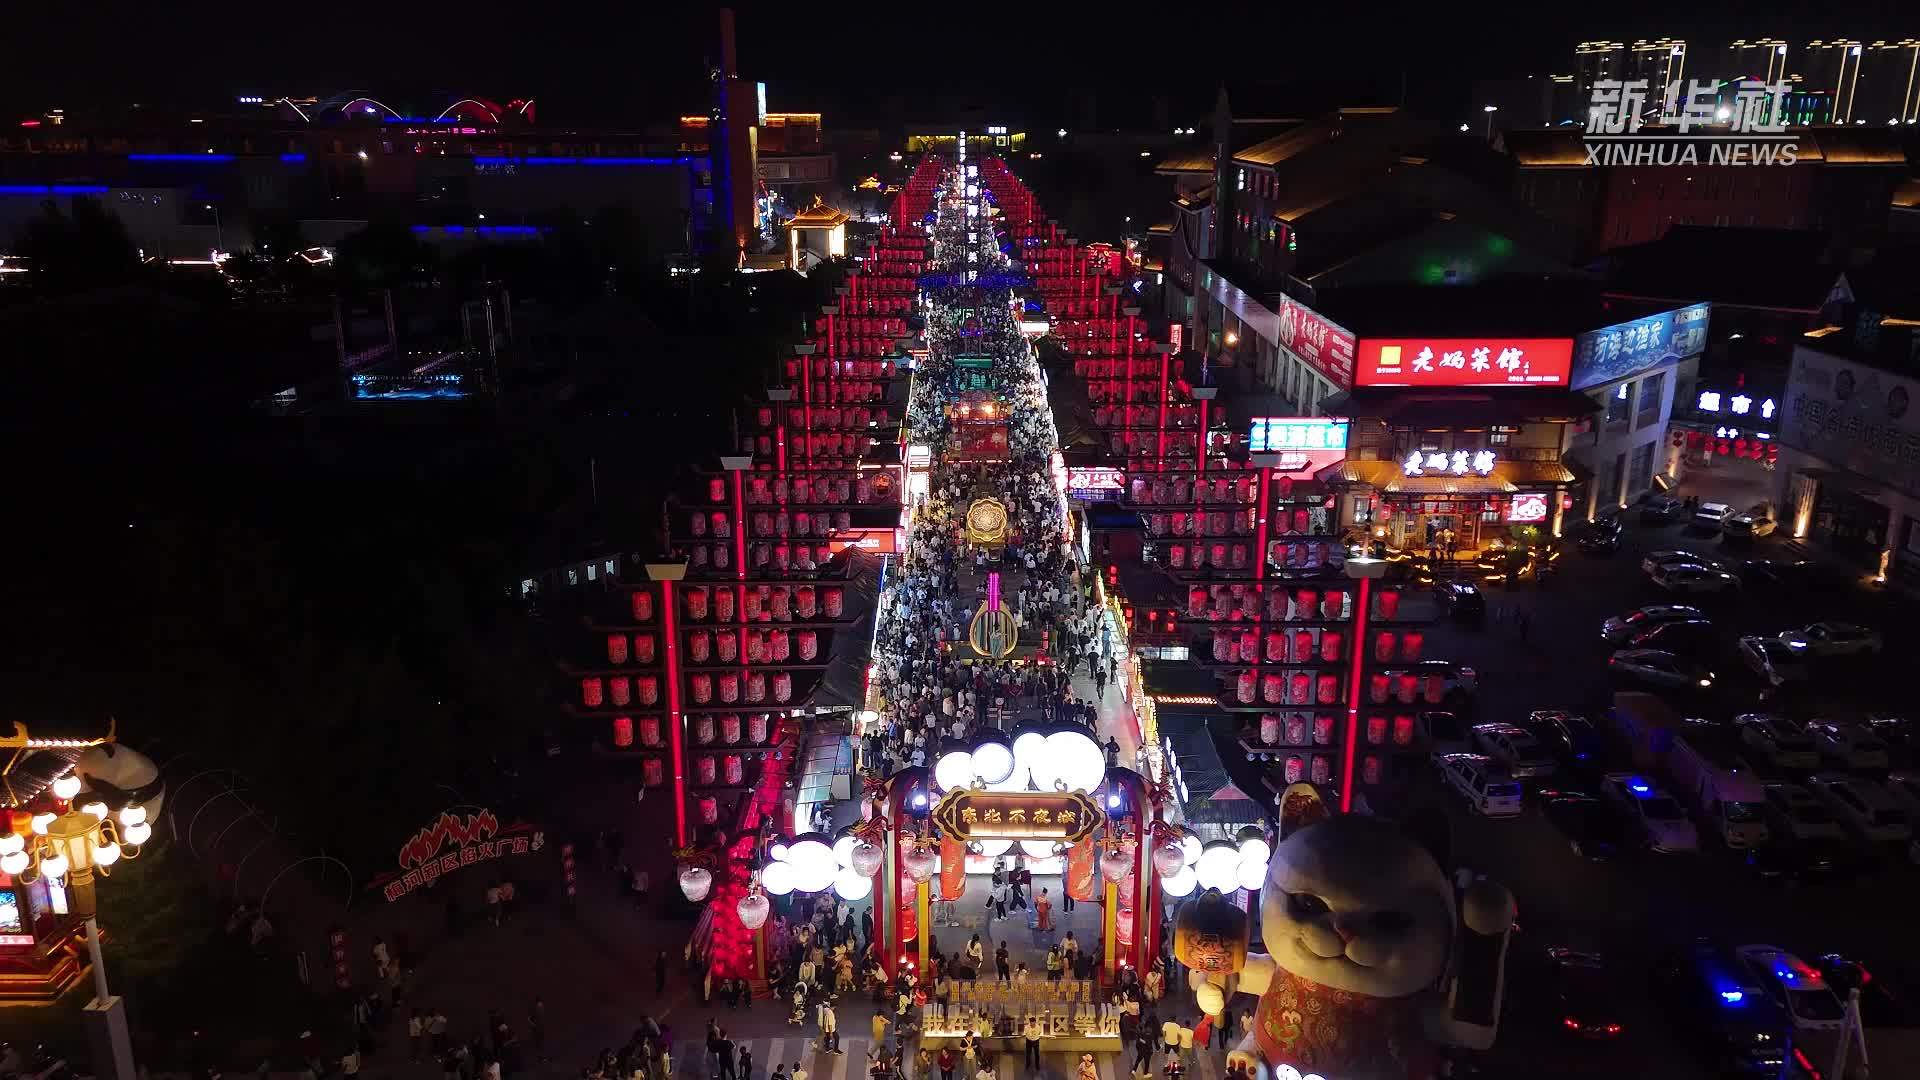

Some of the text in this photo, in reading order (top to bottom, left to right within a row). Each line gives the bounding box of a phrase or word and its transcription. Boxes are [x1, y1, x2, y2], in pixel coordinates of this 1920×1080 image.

[1412, 346, 1524, 373] 老妈菜馆
[1404, 450, 1497, 475] 老妈菜馆
[922, 1007, 1121, 1037] 我在区等你
